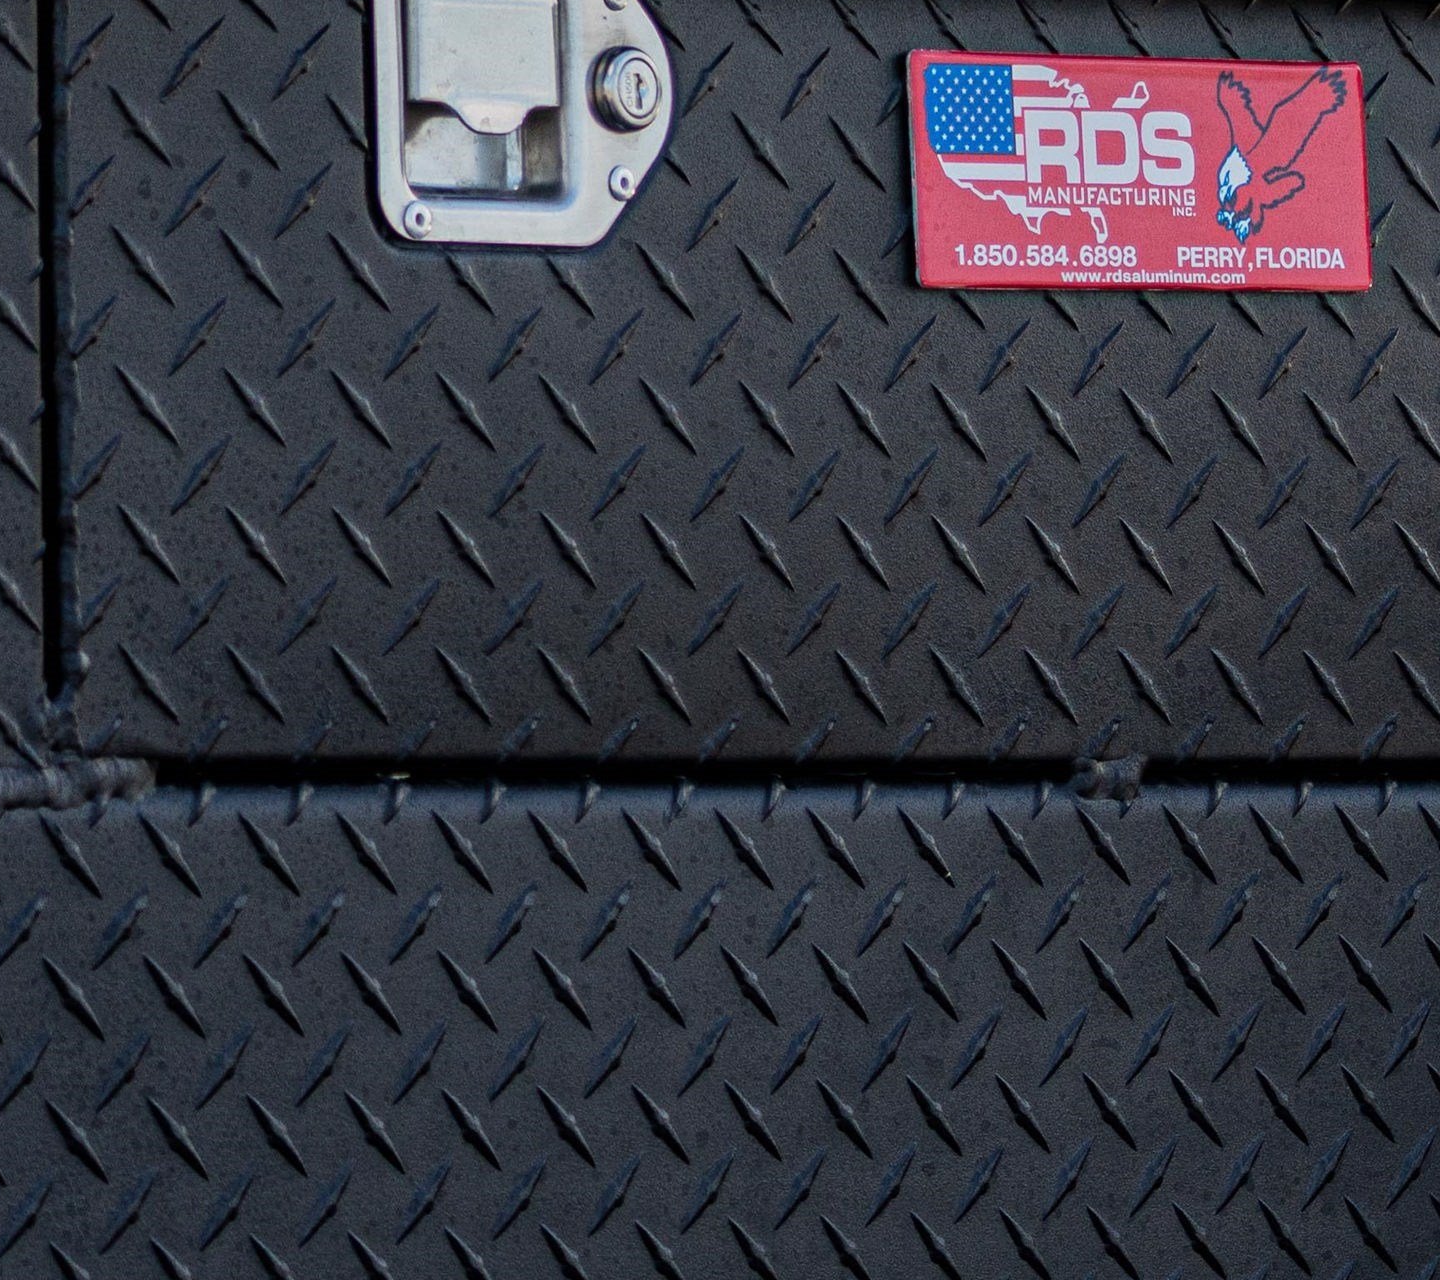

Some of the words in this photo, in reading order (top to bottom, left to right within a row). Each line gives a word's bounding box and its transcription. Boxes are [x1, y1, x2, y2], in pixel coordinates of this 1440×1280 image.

[1024, 109, 1196, 187] RDS
[1027, 186, 1197, 207] MANUFACTURING
[1171, 206, 1197, 217] INC.
[954, 243, 1137, 267] 1.850.584.6898
[1255, 247, 1346, 269] FLORIDA
[1060, 269, 1247, 285] www.rdsaluminum.com
